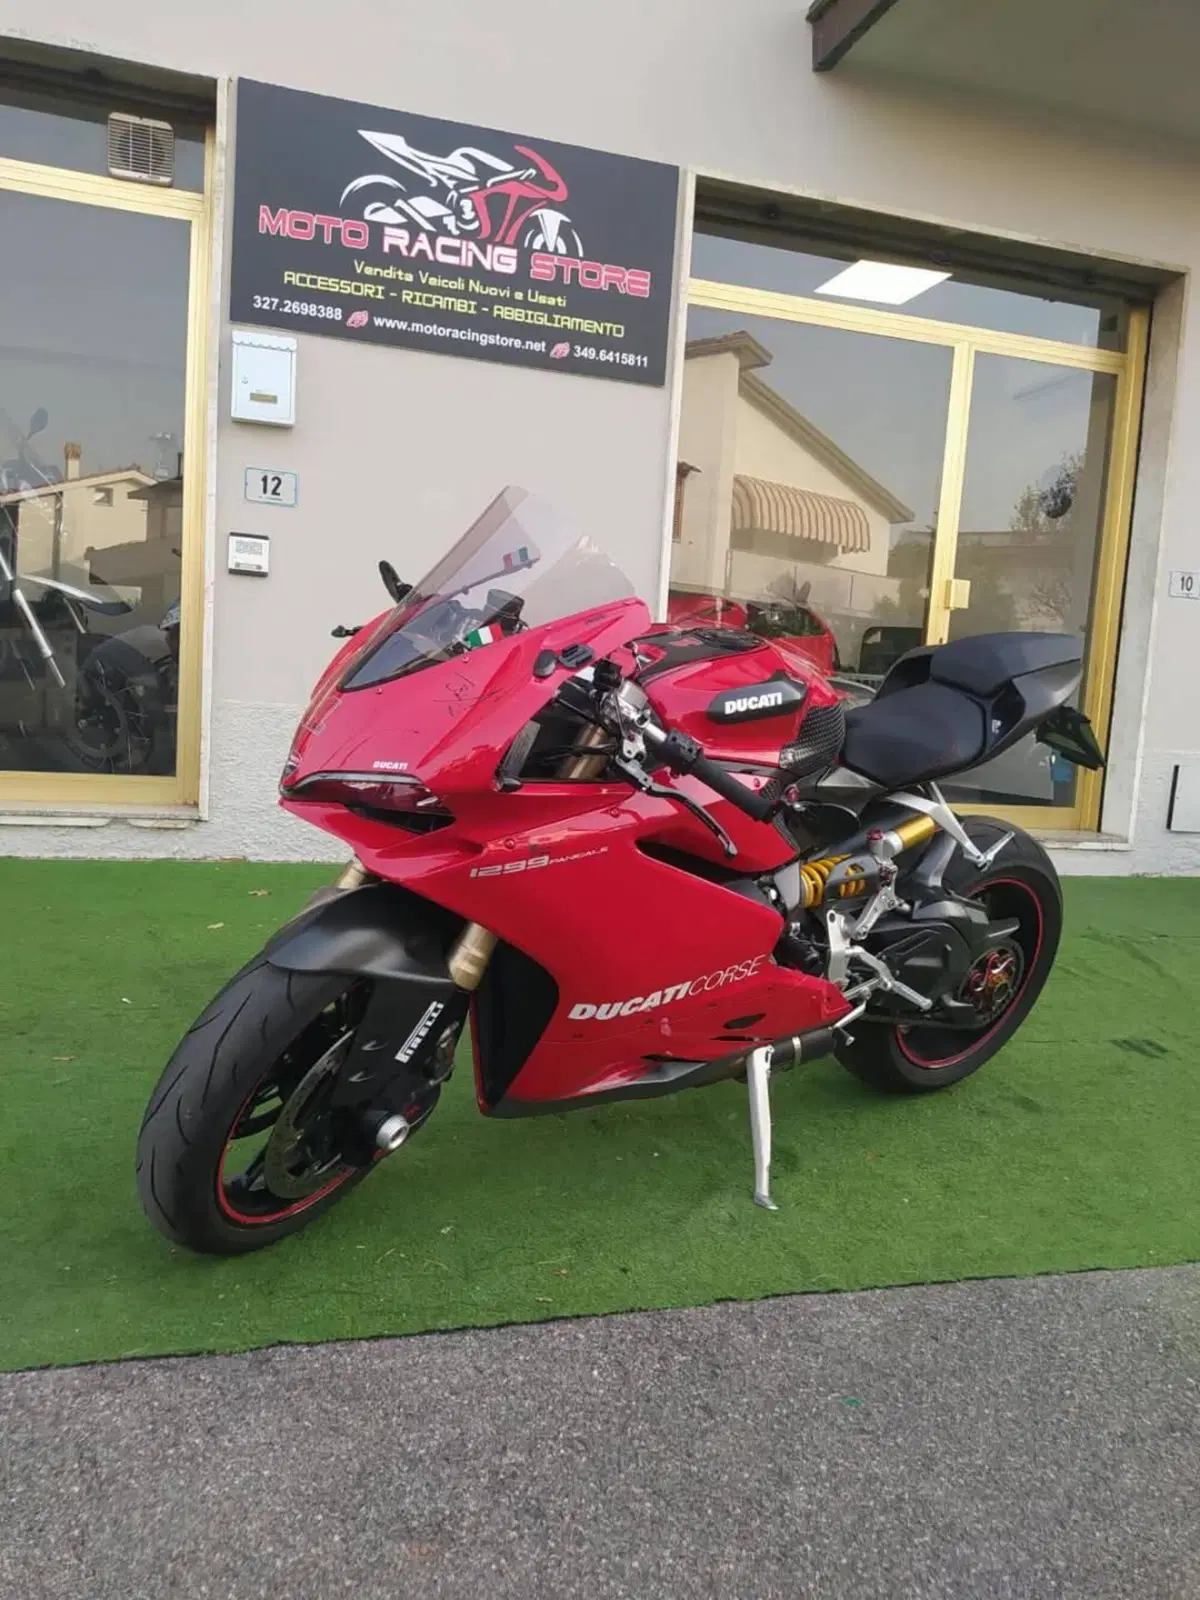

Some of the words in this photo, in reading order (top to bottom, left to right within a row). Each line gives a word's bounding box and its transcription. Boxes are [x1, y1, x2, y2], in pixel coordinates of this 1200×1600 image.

[258, 204, 370, 250] MOTO
[382, 226, 518, 275] RACING
[529, 251, 651, 298] STORE
[354, 259, 414, 283] Vendita
[419, 270, 465, 290] Veicoli
[468, 279, 511, 298] Nuovi
[514, 291, 524, 301] e
[527, 289, 567, 308] Usati
[283, 270, 386, 300] ACCESSORI
[401, 289, 478, 315] RICAMBI
[493, 304, 626, 338] ABBIGLIAMENTO
[252, 295, 343, 321] 327.2698388
[373, 315, 546, 353] www.motoracingstore.net
[573, 345, 649, 369] 349.6415811
[261, 474, 283, 496] 12
[1180, 575, 1194, 592] 10
[724, 692, 783, 715] DUCATI
[372, 760, 409, 771] DUCATI
[469, 855, 550, 878] 1299
[394, 1000, 445, 1064] PIRELLI
